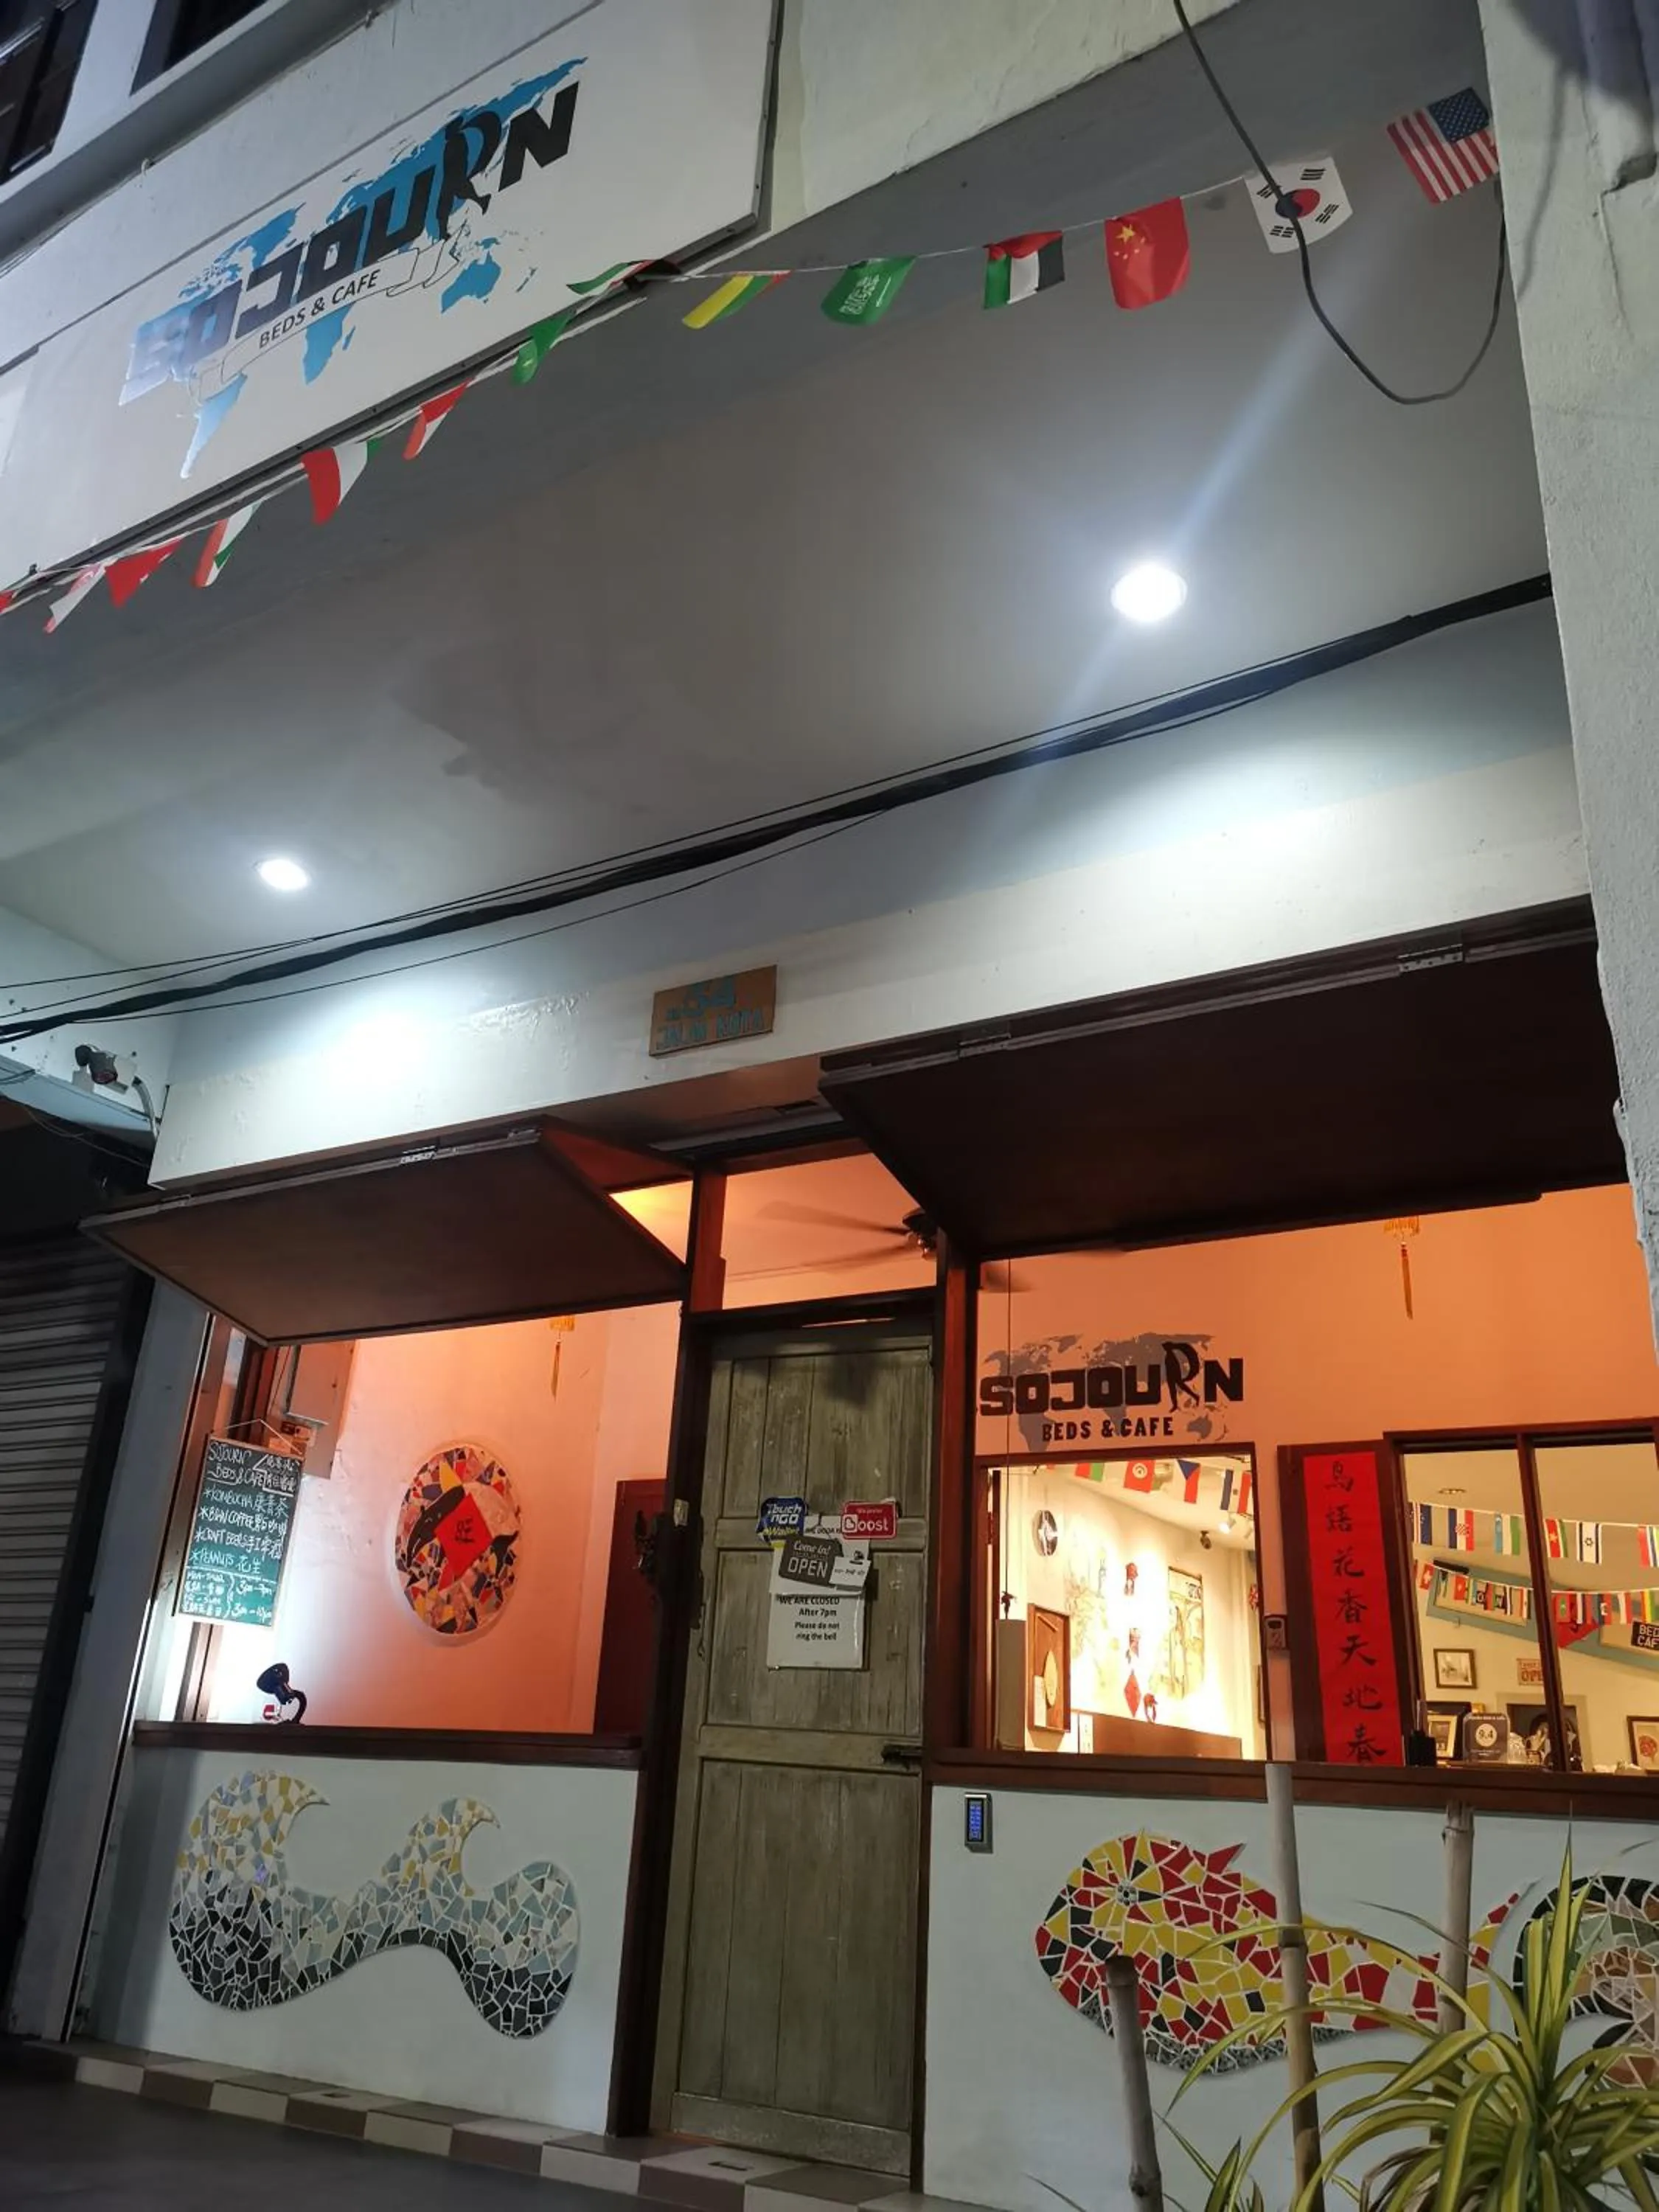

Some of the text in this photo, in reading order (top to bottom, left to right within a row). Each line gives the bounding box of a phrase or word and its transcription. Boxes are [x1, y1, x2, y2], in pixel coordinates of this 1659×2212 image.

[119, 80, 579, 406] SOJOURN
[259, 268, 380, 349] BEDS & CAFE
[980, 1342, 1244, 1416] SOJOURN
[1043, 1416, 1174, 1441] BEDS & CAFE
[767, 1503, 801, 1514] Touch
[787, 1557, 828, 1578] OPEN
[810, 1596, 840, 1605] CLOSED
[799, 1608, 837, 1618] After 7pm
[824, 1632, 837, 1641] bell
